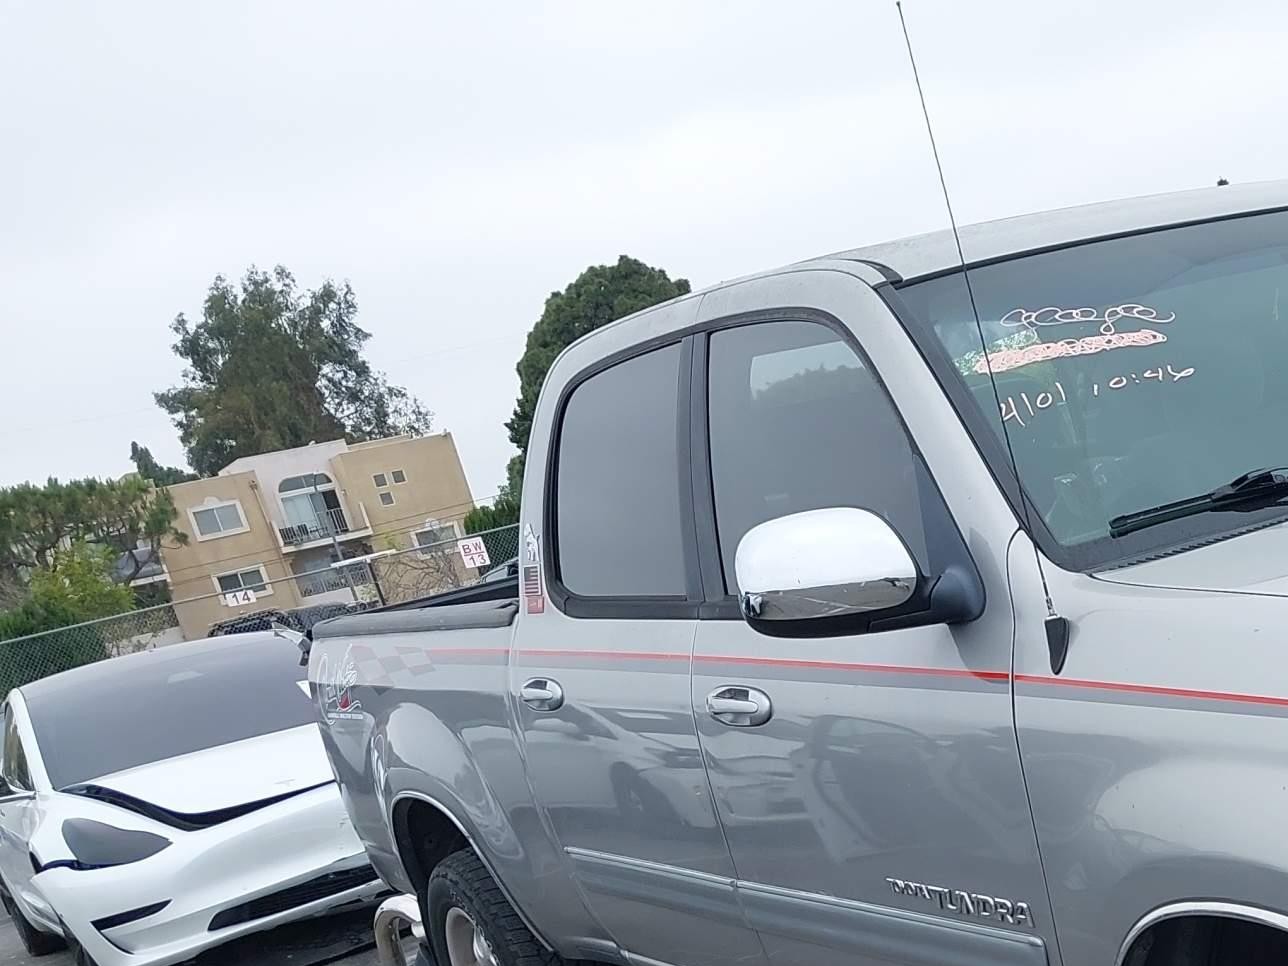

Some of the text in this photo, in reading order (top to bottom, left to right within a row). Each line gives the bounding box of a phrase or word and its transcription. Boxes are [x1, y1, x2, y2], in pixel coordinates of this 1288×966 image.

[470, 554, 486, 566] 13
[232, 591, 251, 604] 14
[928, 886, 1035, 928] TUNDRA
